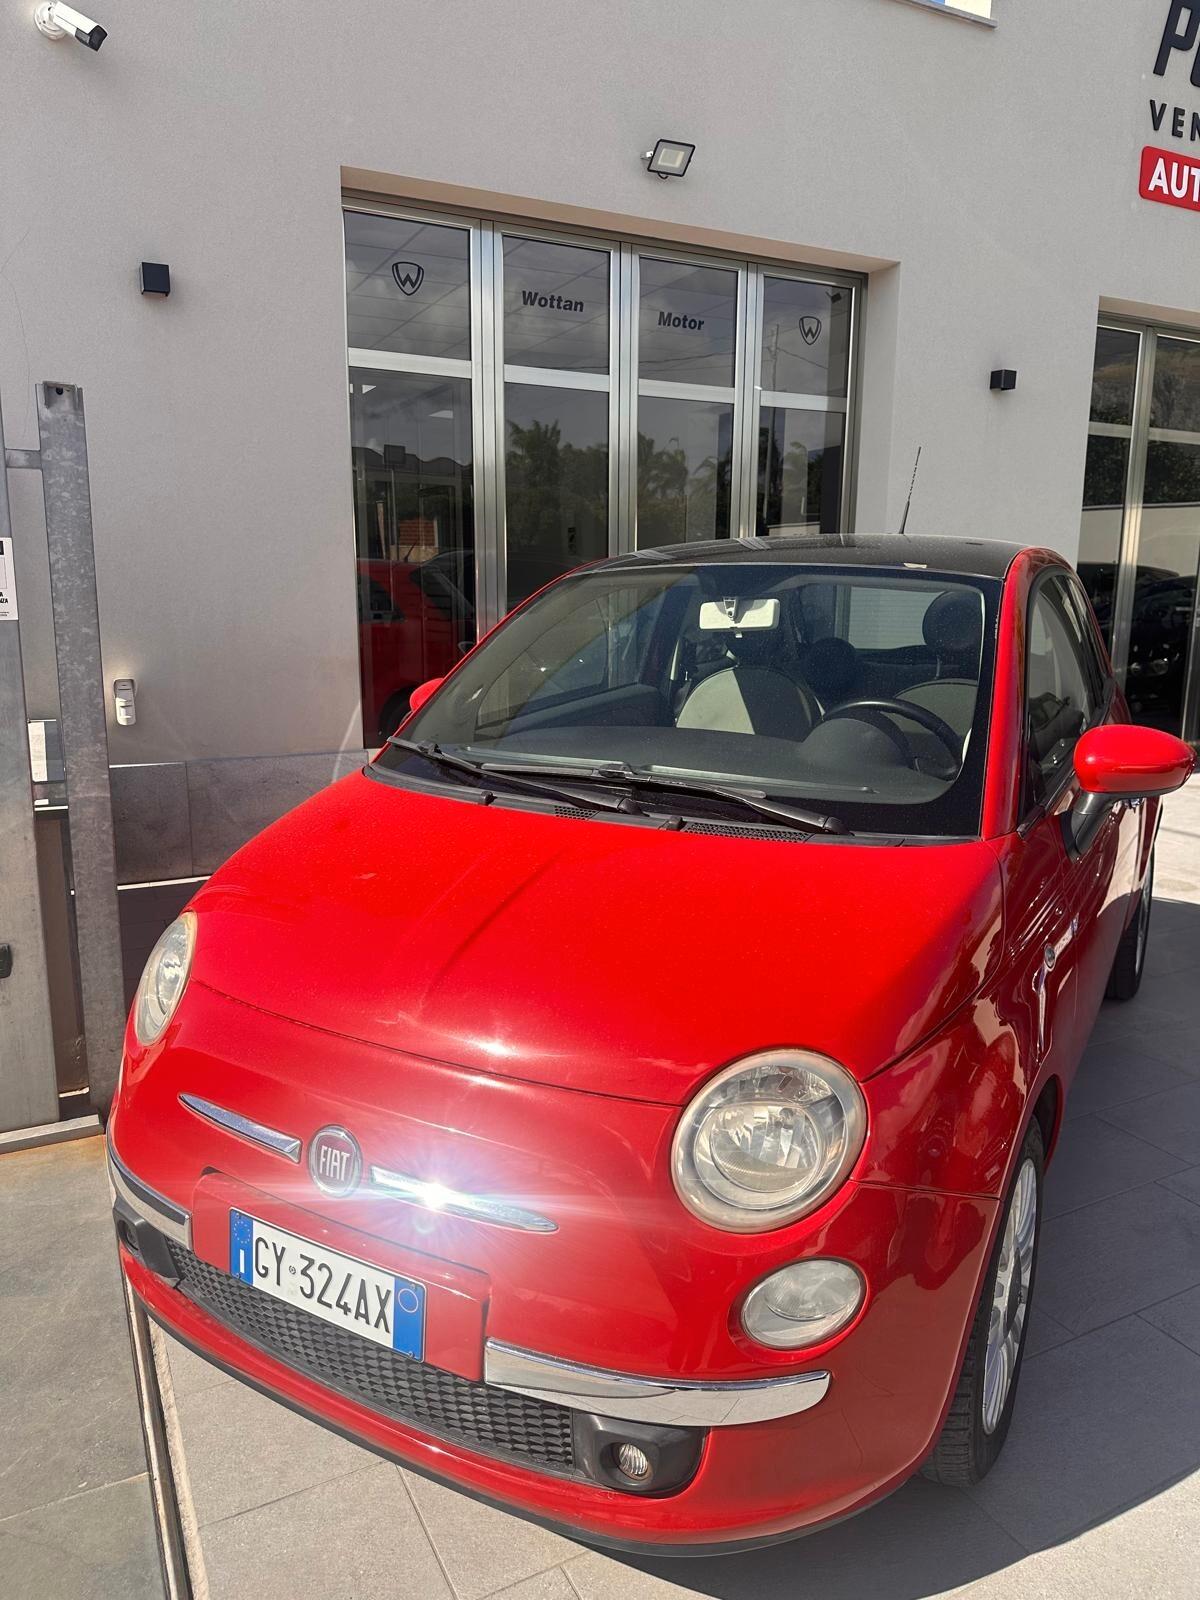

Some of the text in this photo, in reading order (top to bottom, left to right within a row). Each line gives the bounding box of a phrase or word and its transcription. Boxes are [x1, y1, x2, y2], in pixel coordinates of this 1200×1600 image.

[1153, 0, 1200, 87] P
[522, 290, 705, 330] Wottan Motor
[319, 1145, 351, 1181] FIAT
